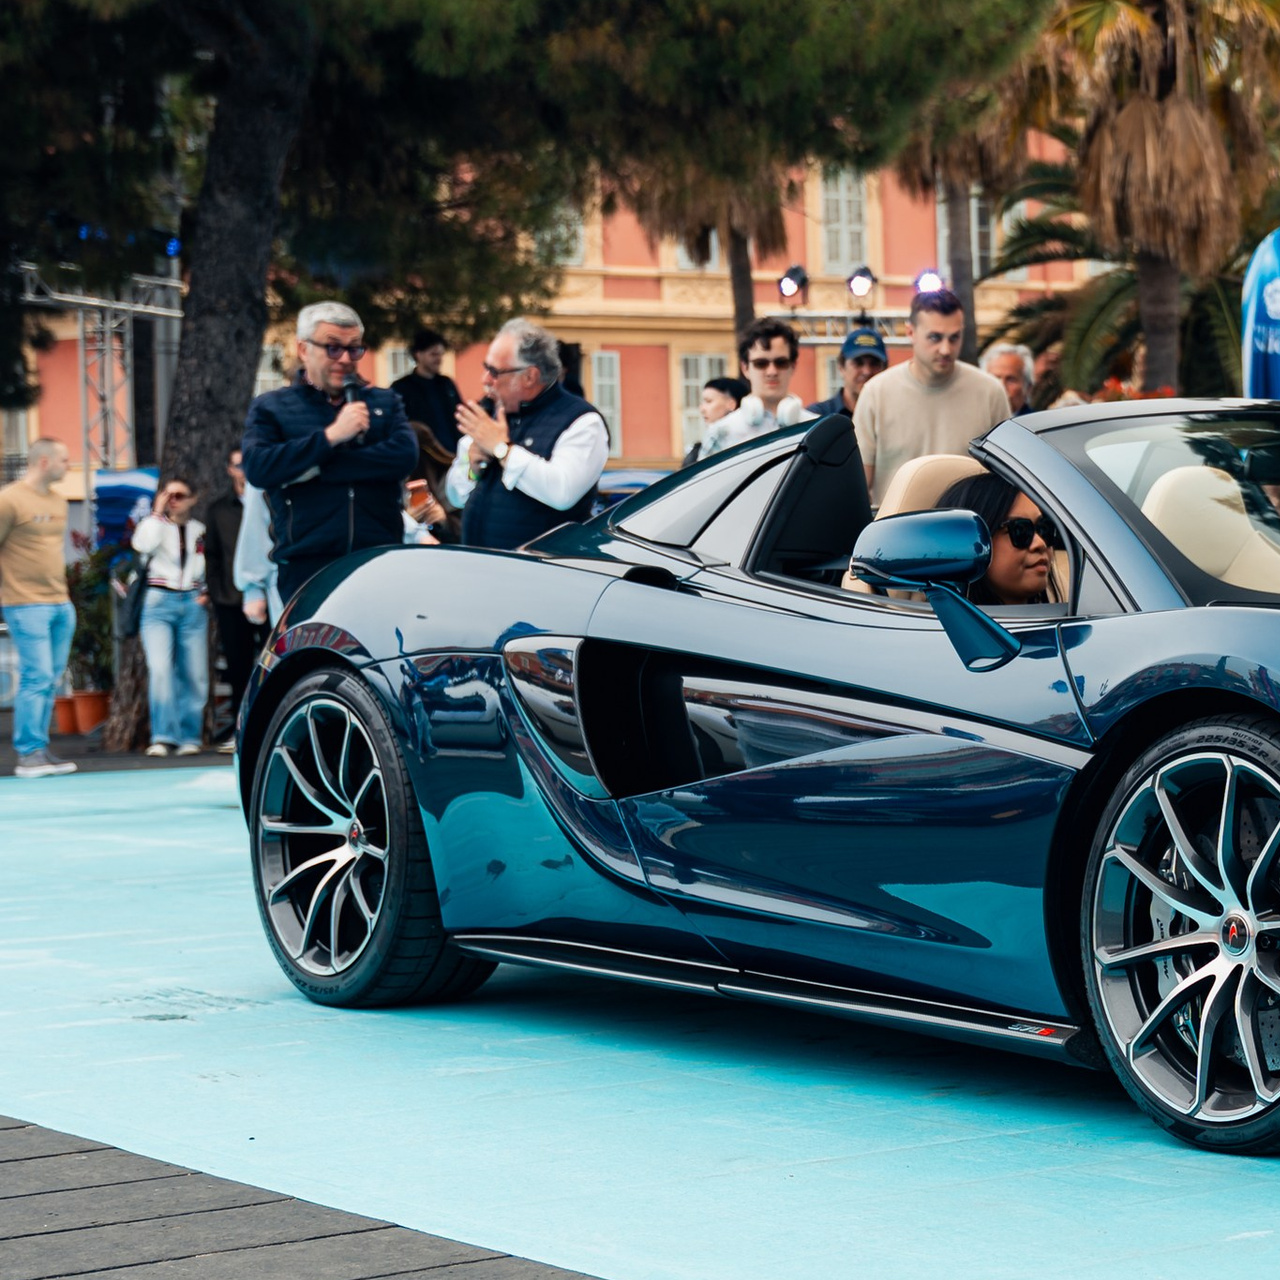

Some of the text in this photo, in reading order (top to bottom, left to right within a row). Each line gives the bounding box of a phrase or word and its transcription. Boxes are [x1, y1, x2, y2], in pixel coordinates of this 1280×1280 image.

[1196, 734, 1245, 749] 225/35
[1247, 744, 1269, 761] ZR
[1232, 731, 1264, 746] OUTSIDE
